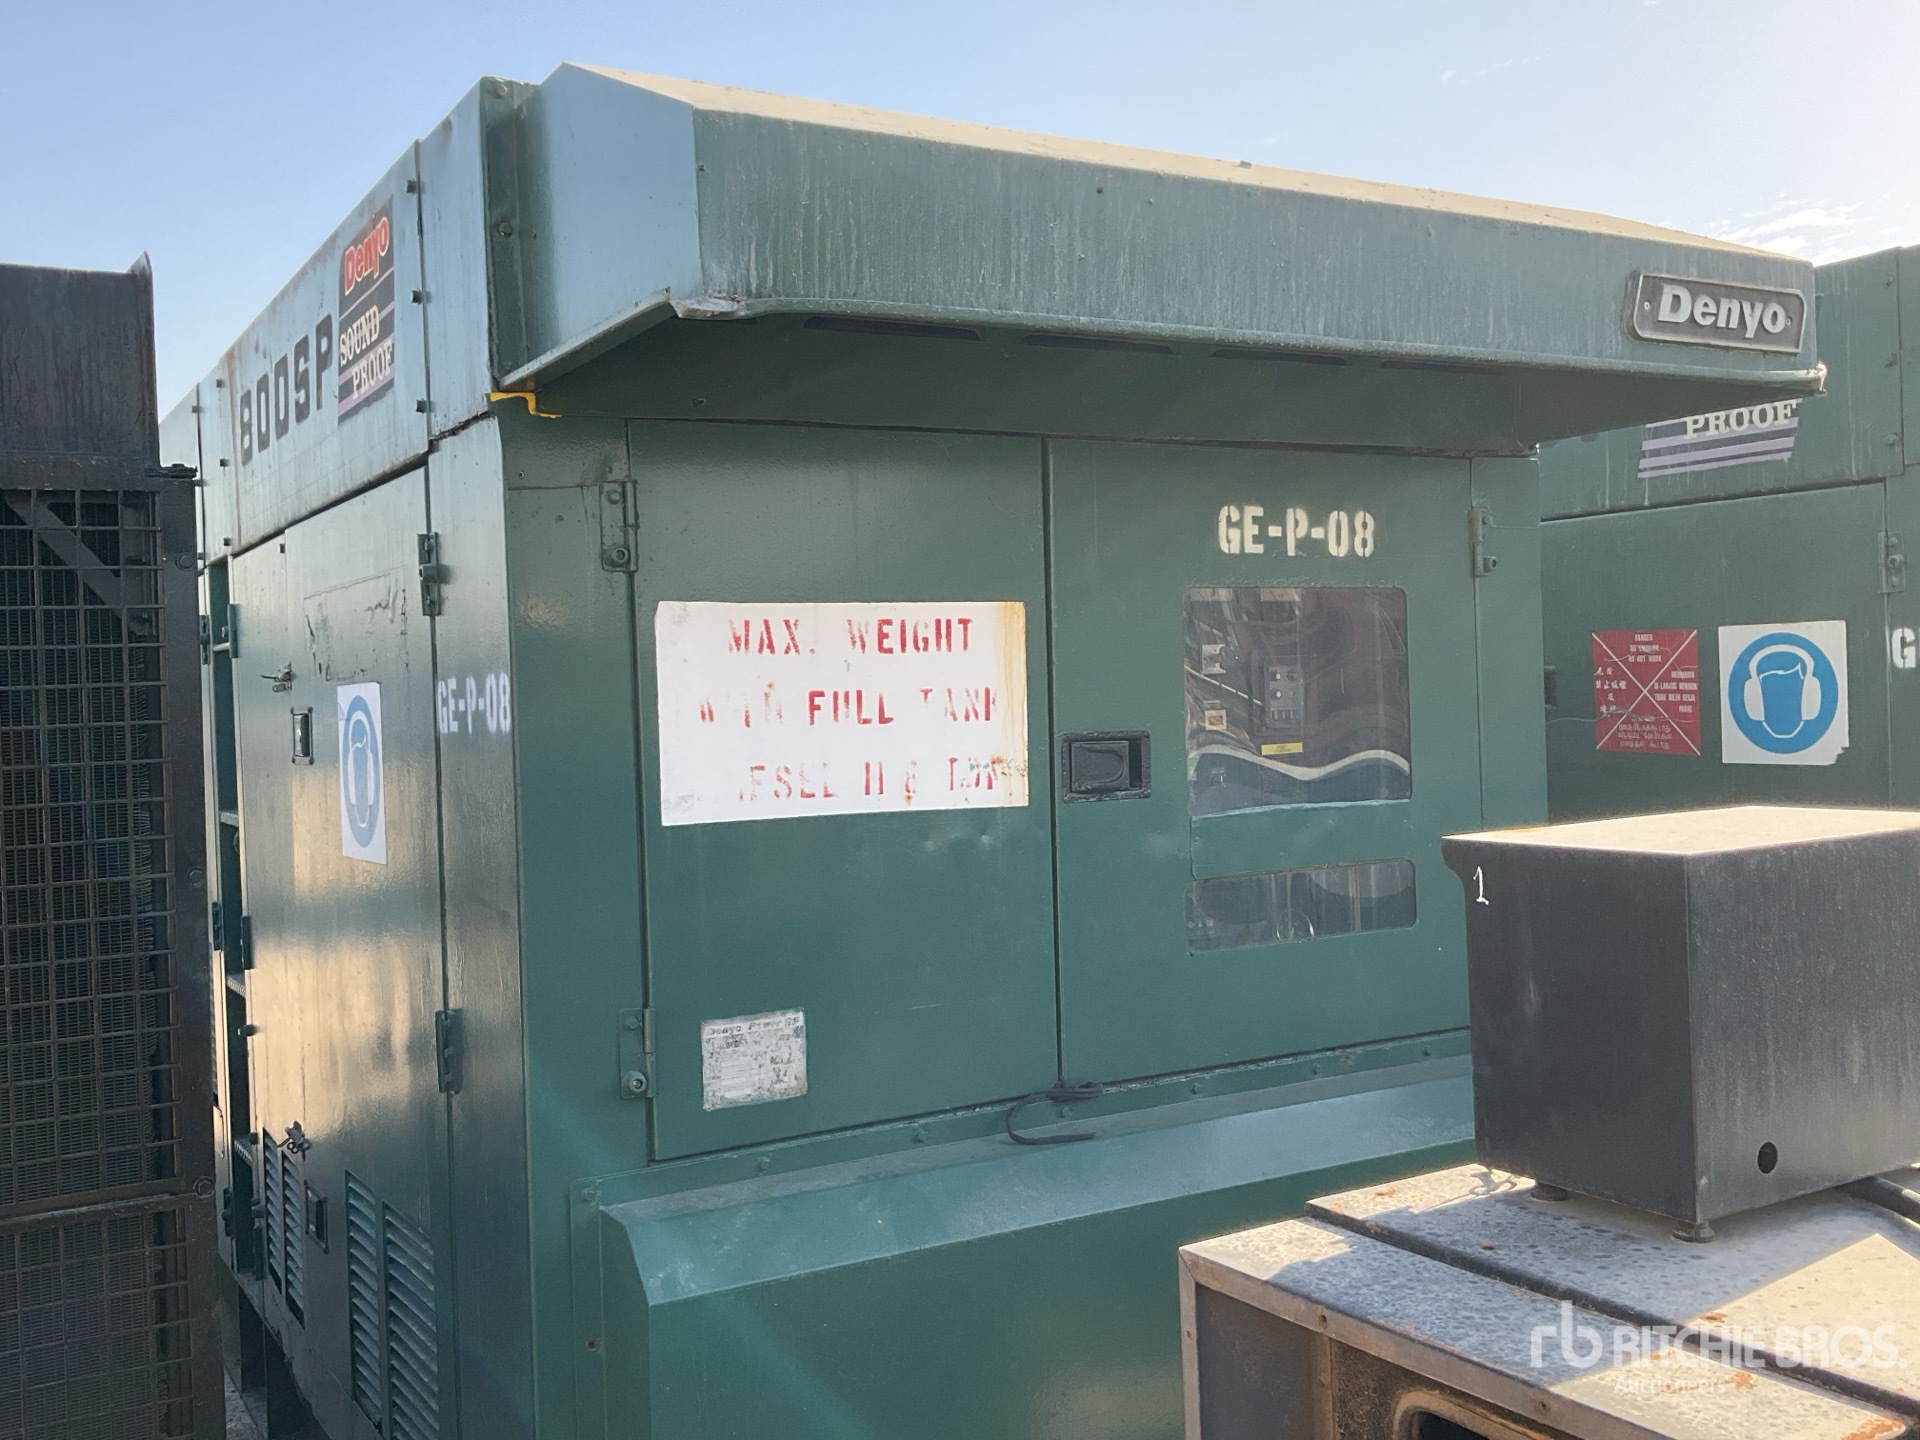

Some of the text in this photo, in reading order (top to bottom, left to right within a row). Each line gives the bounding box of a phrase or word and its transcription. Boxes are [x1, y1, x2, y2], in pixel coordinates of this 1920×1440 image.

[344, 216, 390, 296] Denyo
[340, 304, 380, 368] SOUND
[1658, 283, 1787, 339] Denyo
[239, 313, 334, 467] 800SP
[352, 338, 393, 400] PROOF
[1683, 400, 1799, 440] PROOF
[1217, 504, 1376, 558] GE-P-08
[728, 617, 974, 656] MAX. WEIGHT
[437, 671, 512, 735] GE-P-08
[1472, 865, 1490, 906] 1
